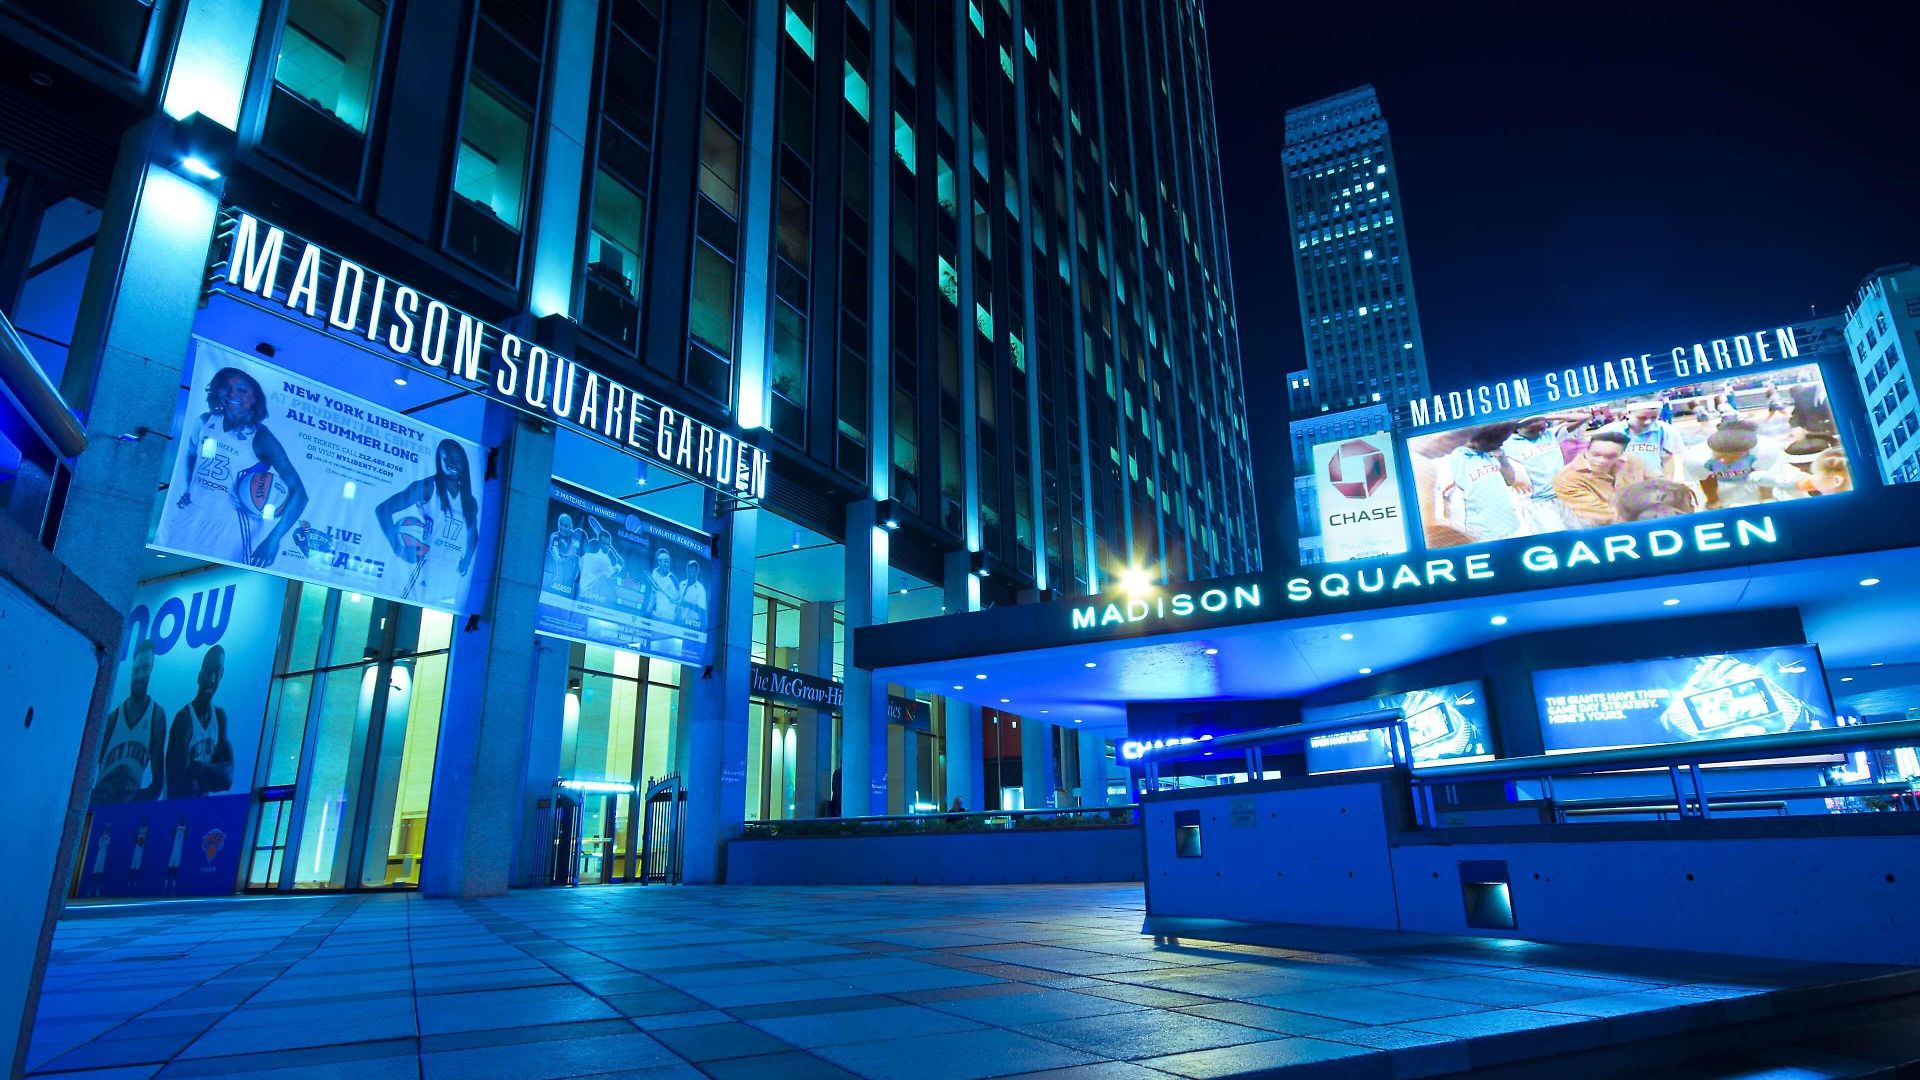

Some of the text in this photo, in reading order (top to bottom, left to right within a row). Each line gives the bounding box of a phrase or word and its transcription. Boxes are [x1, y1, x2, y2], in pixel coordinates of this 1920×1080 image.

[227, 213, 768, 499] MADISON SQUARE GARDEN
[1409, 326, 1800, 428] MADISON SQUARE GARDEN
[270, 391, 432, 457] AT PRUDENTIAL CENTER
[283, 381, 425, 442] NEW YORK LIBERTY
[286, 408, 420, 464] ALL SUMMER LONG
[298, 431, 313, 442] FOR
[341, 446, 358, 458] CALL
[197, 453, 230, 481] 23
[307, 444, 318, 454] OR
[318, 447, 336, 459] VISIT
[336, 454, 394, 478] NYLIBERTY.COM
[442, 515, 464, 541] 17
[594, 506, 617, 519] WINNER!
[1329, 505, 1398, 527] CHASE
[326, 525, 362, 545] LIVE
[1072, 516, 1777, 629] MADISON SQUARE GARDEN
[751, 667, 769, 691] The
